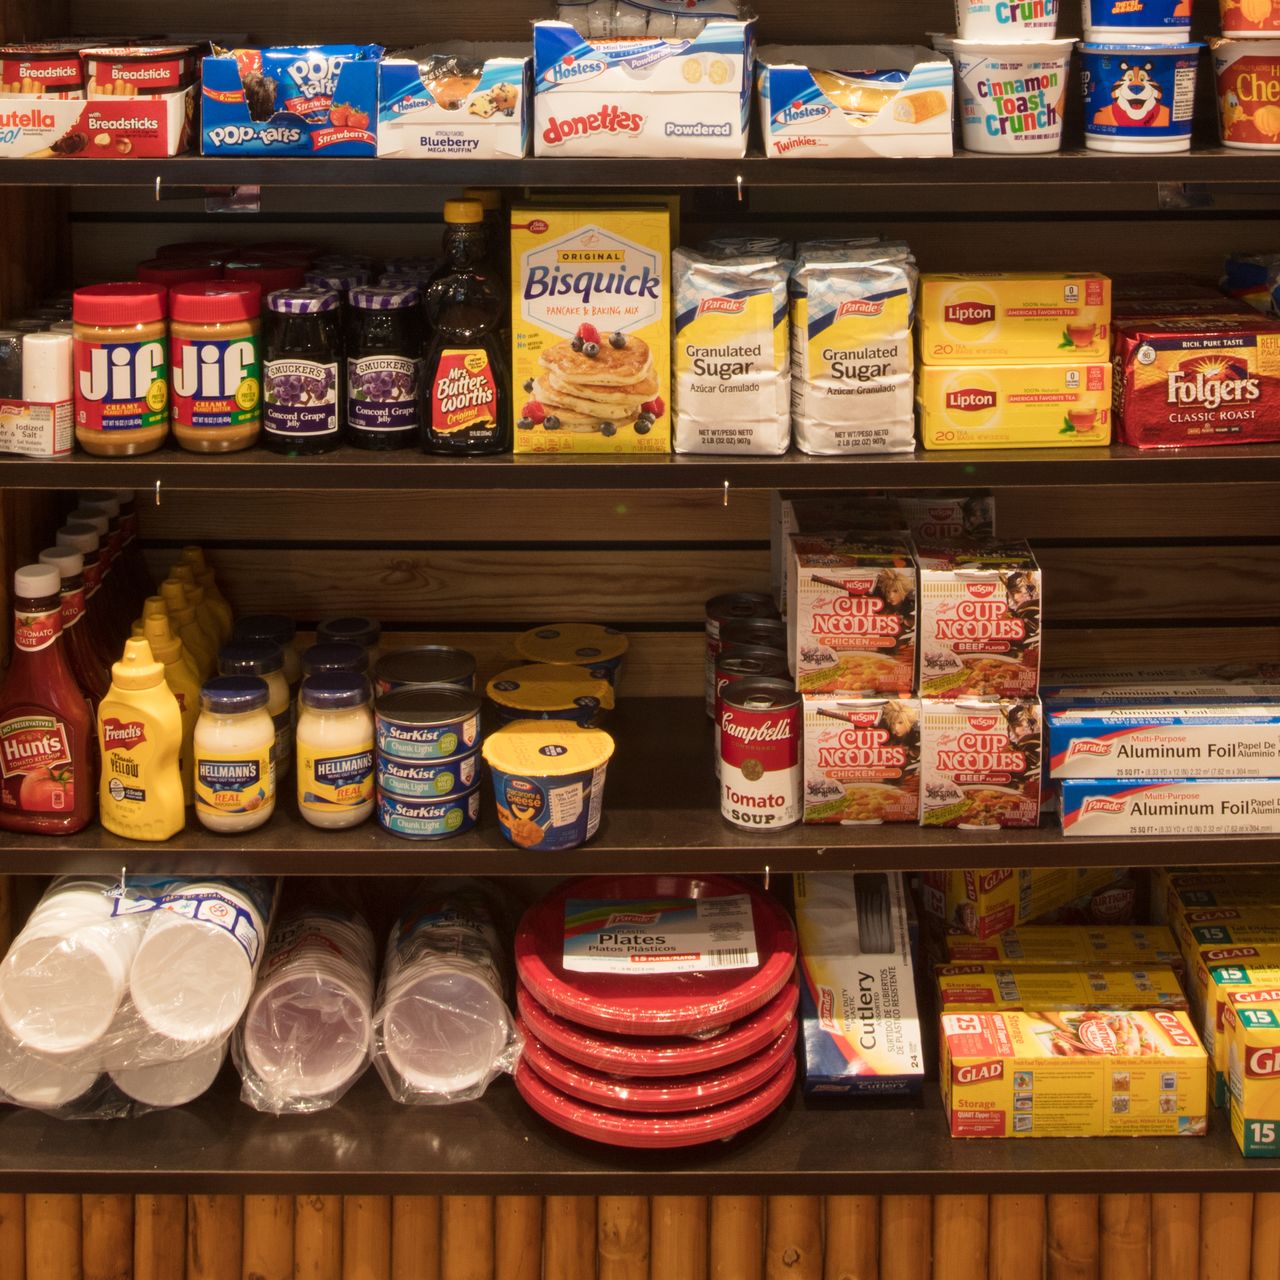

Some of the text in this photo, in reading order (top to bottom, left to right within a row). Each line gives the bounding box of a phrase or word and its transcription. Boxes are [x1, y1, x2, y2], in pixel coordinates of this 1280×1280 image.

[89, 118, 158, 130] Breadsticks
[544, 105, 643, 145] donettes
[666, 123, 731, 136] Powdered
[421, 136, 479, 149] Blueberry
[562, 252, 620, 260] ORIGINAL
[524, 266, 660, 303] Bisquick
[546, 306, 639, 316] PANCAKE & BAKING MIX
[948, 306, 992, 321] Lipton
[686, 345, 762, 358] Granulated
[934, 345, 953, 355] 20
[82, 347, 166, 400] Jif
[693, 359, 754, 380] Sugar
[690, 383, 759, 394] Azúcar Granulado
[1166, 373, 1260, 404] Folgers
[268, 411, 325, 424] Concord Grape
[1169, 409, 1256, 424] CLASSIC ROAST
[957, 602, 1006, 619] CUP
[937, 621, 1024, 640] NOODLES
[825, 638, 869, 646] CHICKEN
[959, 642, 984, 651] BEEF
[1131, 735, 1186, 744] Multi-Purpose
[1117, 743, 1236, 759] Aluminum Foil
[1238, 742, 1276, 751] Papel De
[1238, 749, 1276, 757] Aluminio
[214, 792, 241, 804] REAL
[725, 786, 785, 809] Tomato
[732, 810, 775, 824] SOUP
[598, 933, 665, 946] Plates
[588, 943, 676, 954] Platos Plásticos
[859, 971, 875, 1049] Cutlery
[958, 1099, 996, 1110] Storage
[1251, 1124, 1275, 1143] 15
